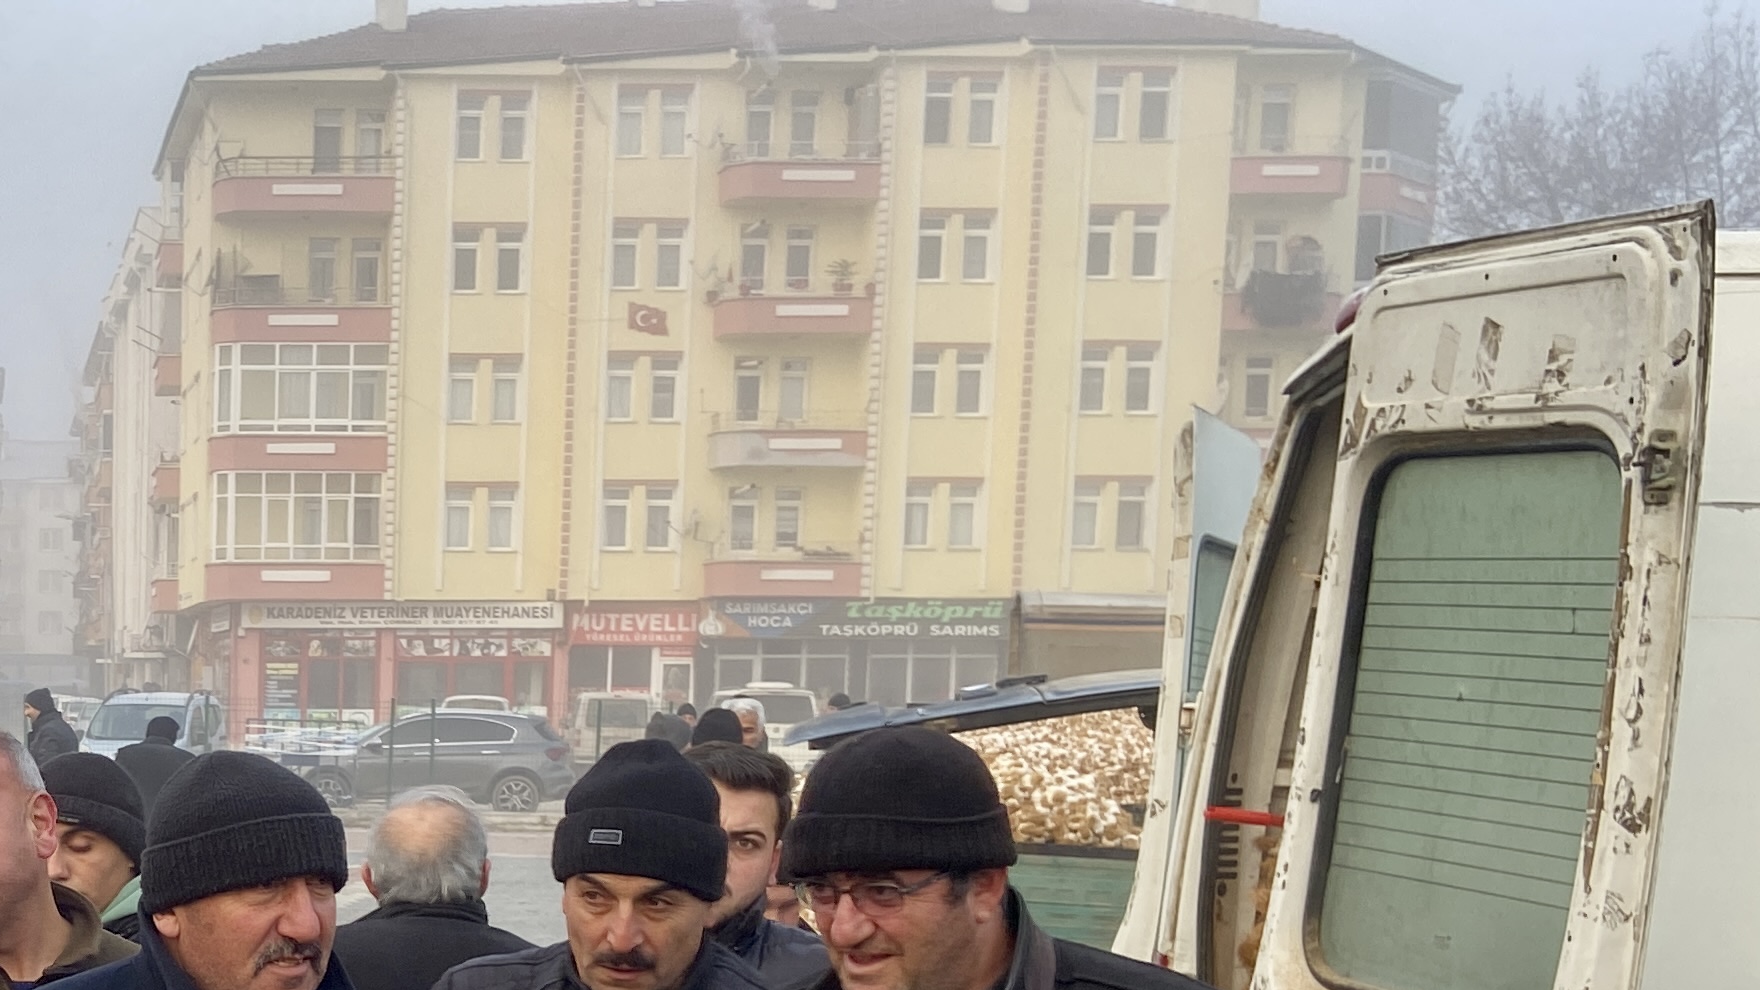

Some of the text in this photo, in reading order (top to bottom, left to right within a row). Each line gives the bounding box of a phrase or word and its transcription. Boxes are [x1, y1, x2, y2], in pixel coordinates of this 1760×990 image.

[266, 603, 554, 619] KARADENİZ VETERİNER MUAYENEHANESİ
[725, 602, 813, 614] SARIMSAKÇI
[846, 600, 1004, 622] Taşköprü
[748, 616, 792, 627] HOCA
[819, 622, 918, 637] TAŞKÖPRÜ
[585, 632, 683, 642] YÖRESEL ÜRÜNLER
